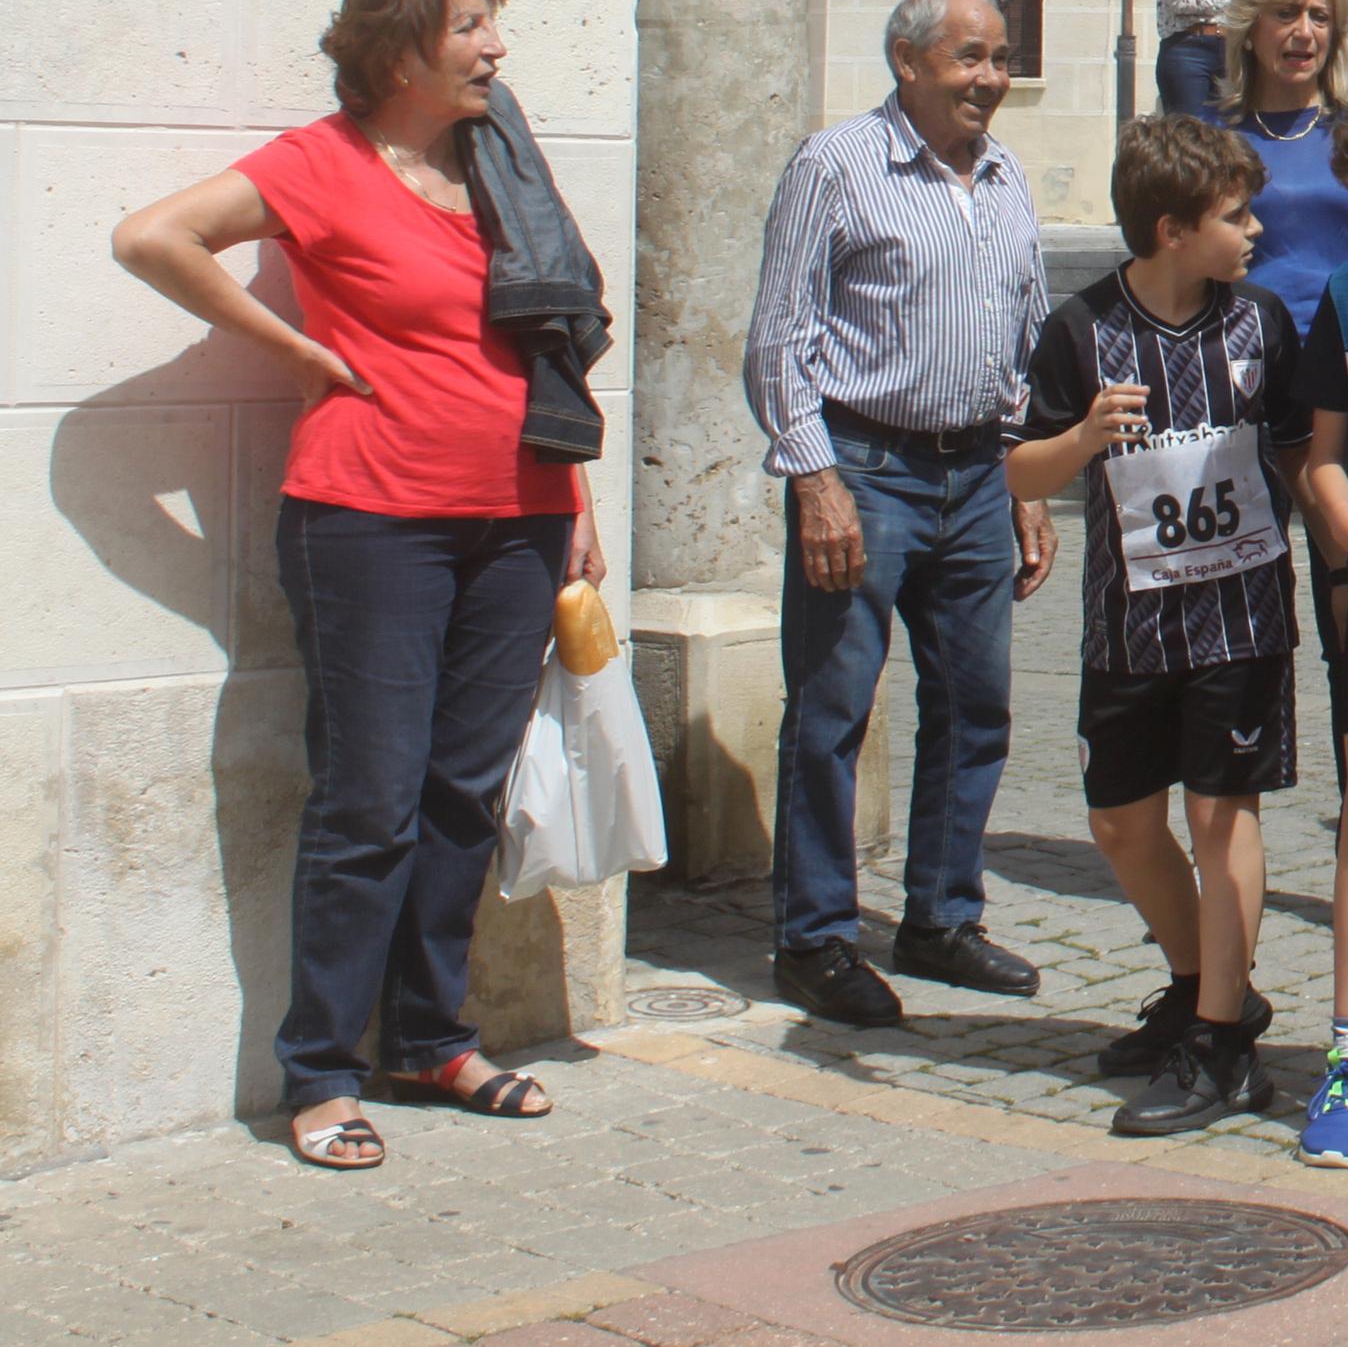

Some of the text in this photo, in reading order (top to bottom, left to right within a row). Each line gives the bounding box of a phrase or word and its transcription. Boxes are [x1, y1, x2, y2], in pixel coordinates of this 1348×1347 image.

[1152, 478, 1240, 549] 865
[1152, 559, 1233, 583] Caja España
